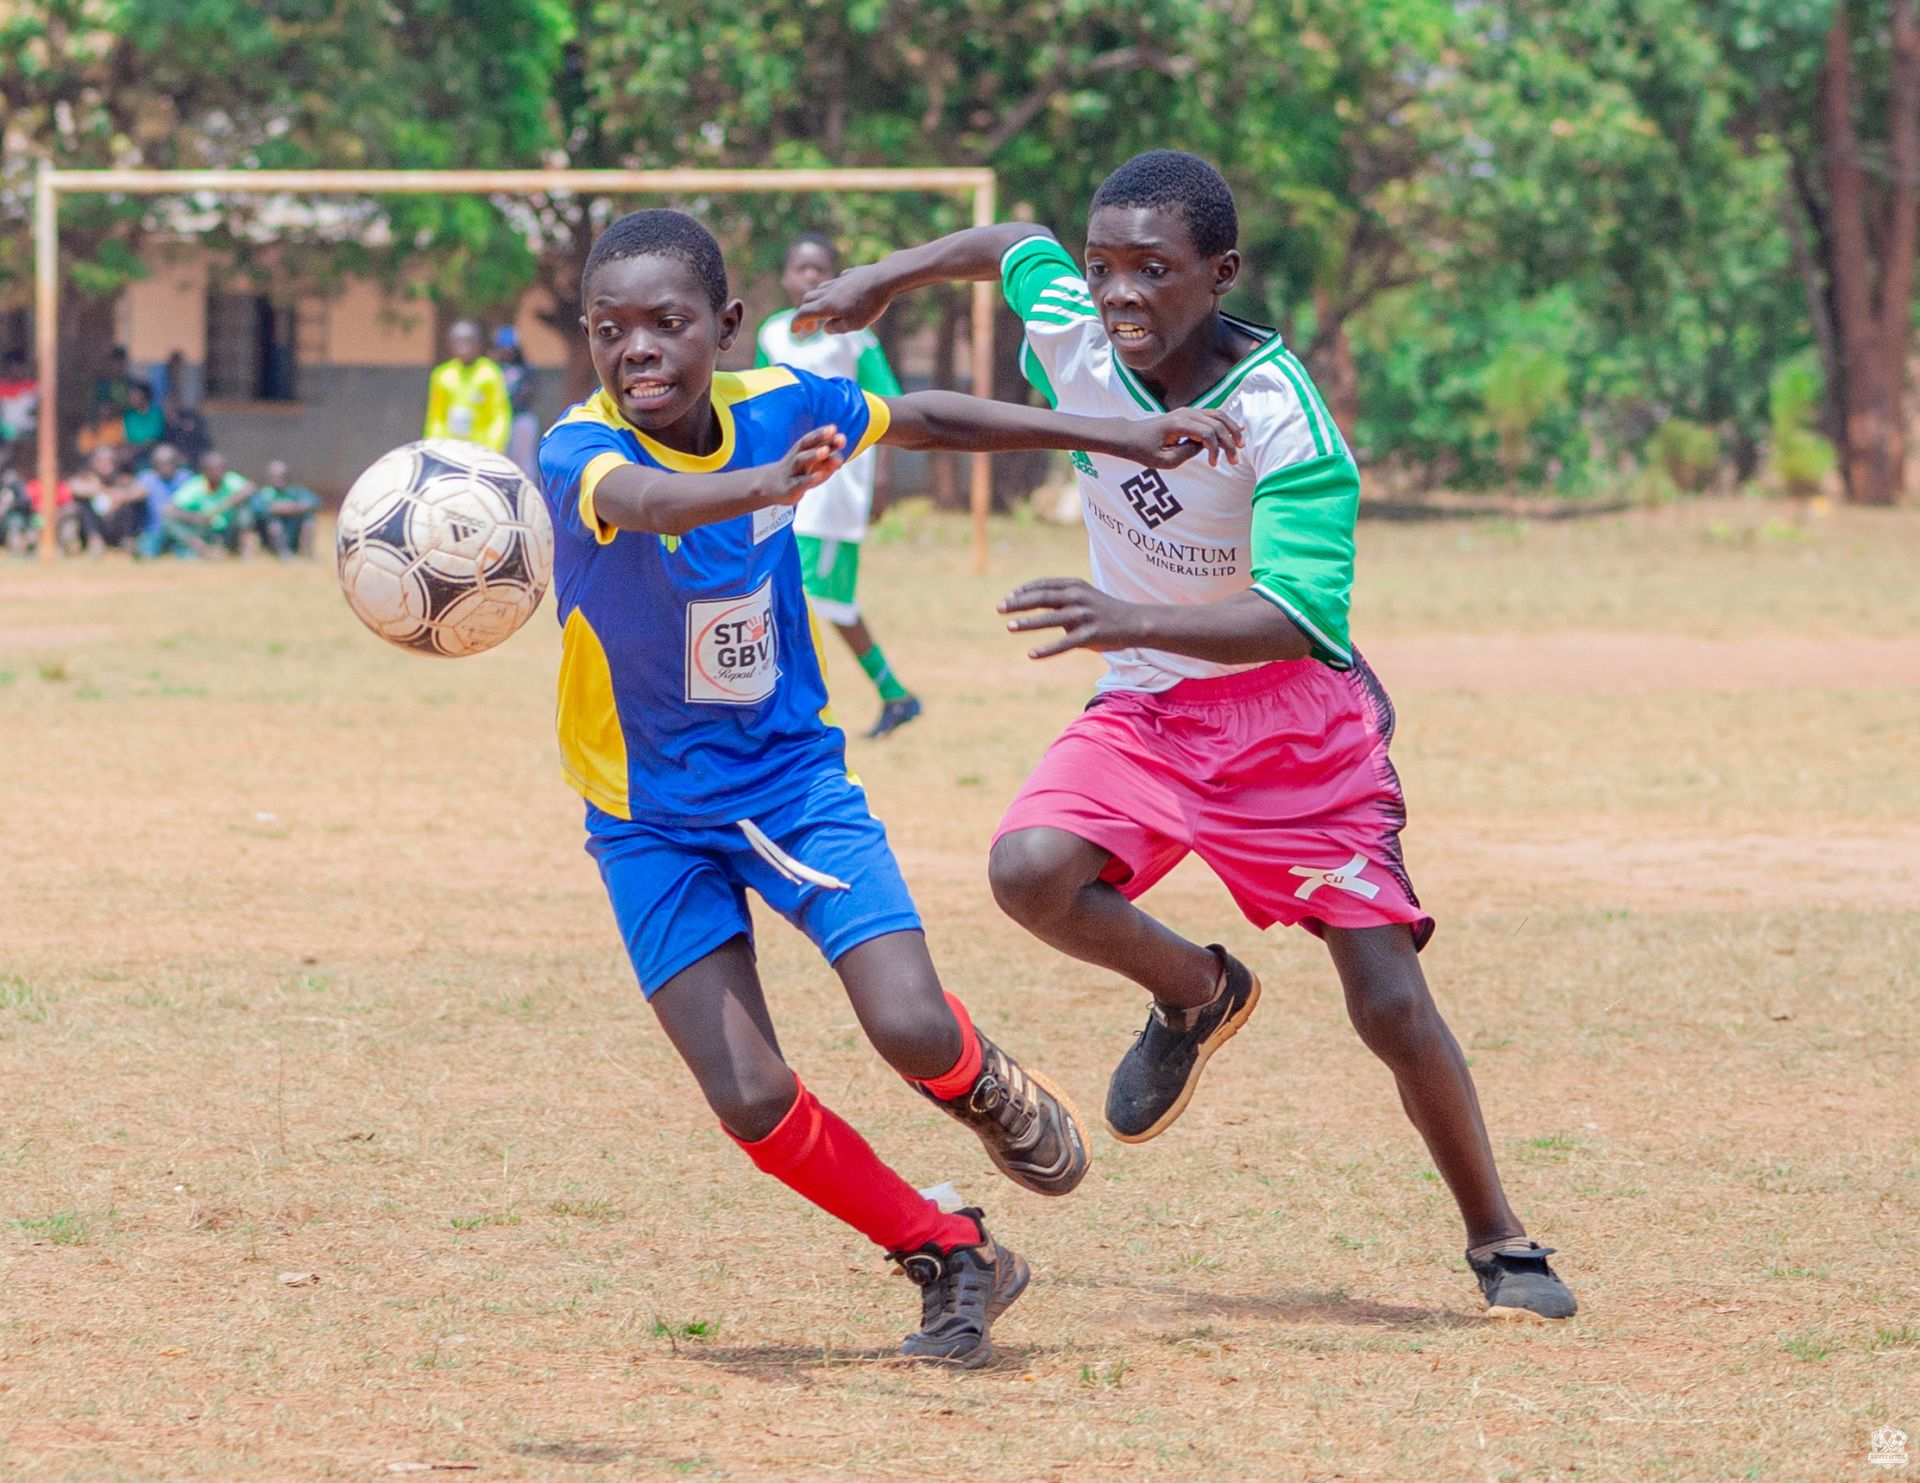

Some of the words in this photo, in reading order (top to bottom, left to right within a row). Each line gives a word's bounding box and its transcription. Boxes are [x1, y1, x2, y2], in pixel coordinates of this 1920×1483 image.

[1087, 496, 1125, 536] FIRST
[1127, 527, 1237, 564] QUANTUM
[1146, 554, 1209, 577] MINERALS
[1212, 566, 1236, 577] LTD
[714, 607, 771, 645] STP
[717, 635, 770, 668] GBV
[714, 666, 757, 683] Report
[1322, 873, 1344, 883] Cu
